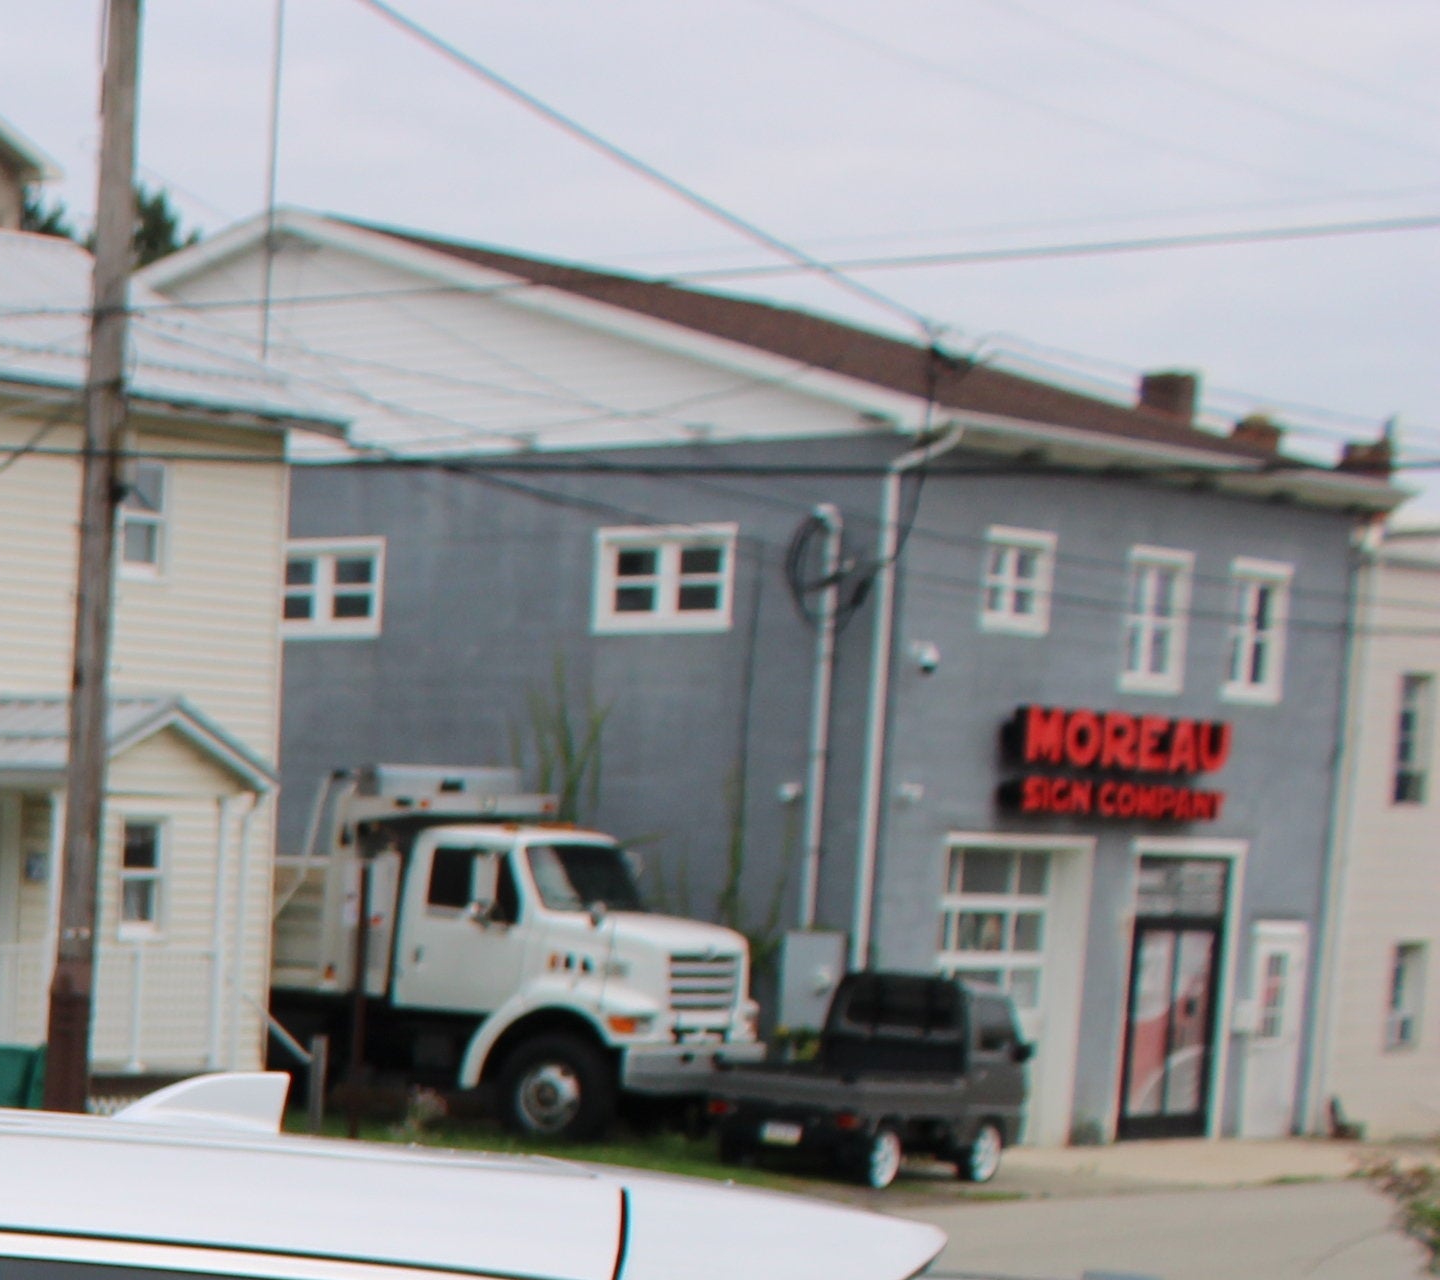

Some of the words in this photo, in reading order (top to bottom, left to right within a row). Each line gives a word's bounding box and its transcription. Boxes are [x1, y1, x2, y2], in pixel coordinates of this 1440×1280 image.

[1026, 705, 1230, 773] MOREAU
[1022, 775, 1092, 813] SIGN
[1099, 780, 1224, 822] COMPANY
